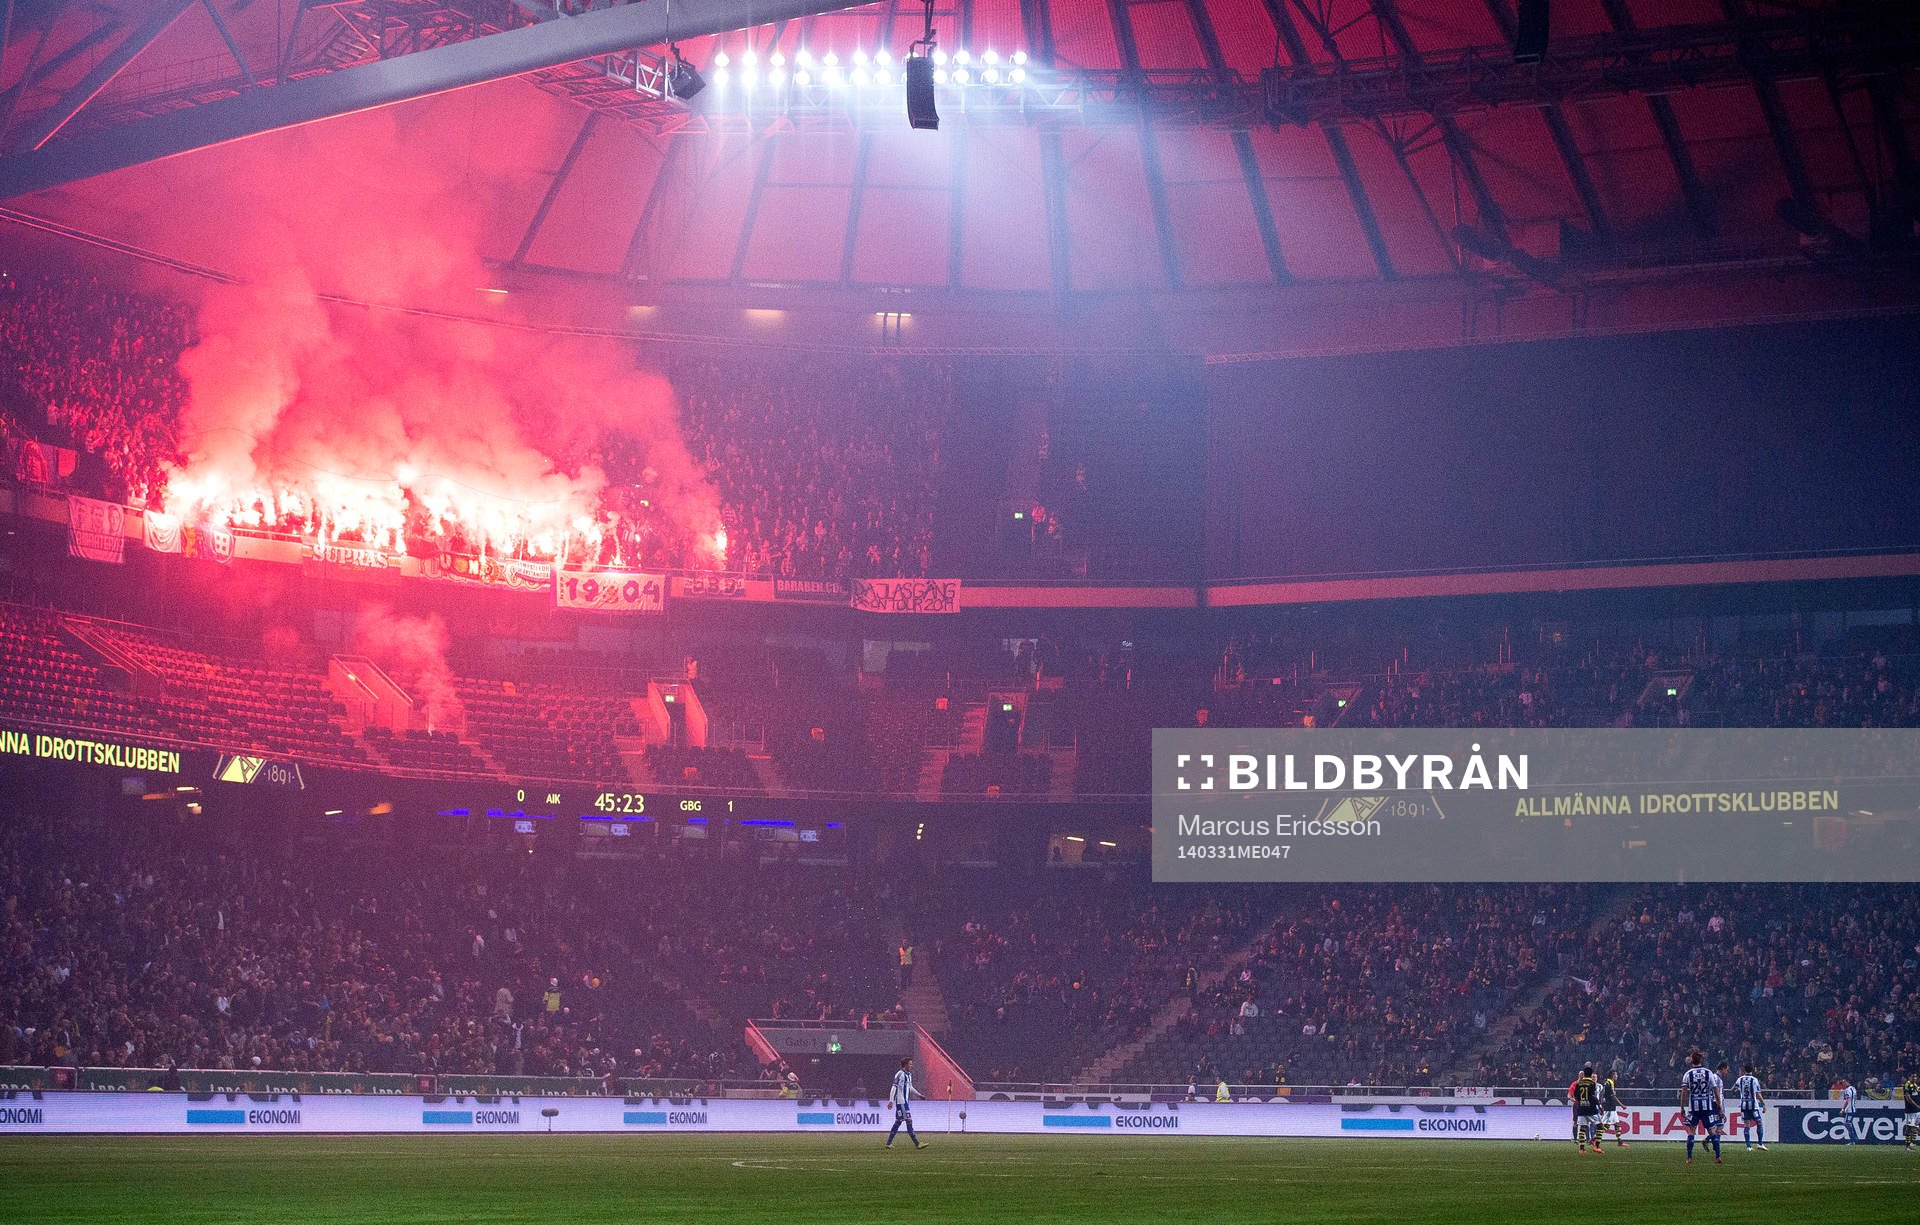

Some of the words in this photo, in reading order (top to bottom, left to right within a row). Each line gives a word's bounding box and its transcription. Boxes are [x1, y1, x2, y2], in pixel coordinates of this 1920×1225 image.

[312, 544, 389, 569] SUPRAS
[565, 577, 599, 602] 19
[35, 735, 180, 774] IDROTTSKLUBBEN
[517, 789, 525, 802] 0
[546, 793, 561, 805] AIK
[594, 792, 645, 814] 45:23
[680, 800, 702, 812] GBG
[727, 800, 733, 812] 1
[1391, 800, 1426, 817] 1891
[1515, 792, 1632, 816] ALLMÄNNA
[1640, 790, 1839, 814] IDROTTSKLUBBEN
[1580, 1086, 1589, 1100] 21
[1691, 1081, 1709, 1095] 22
[249, 1110, 300, 1124] EKONOMI
[475, 1111, 520, 1124] EKONOMI
[669, 1112, 708, 1124] EKONOMI
[836, 1113, 880, 1124] EKONOMI
[1115, 1116, 1179, 1128] EKONOMI
[1418, 1118, 1486, 1131] EKONOMI
